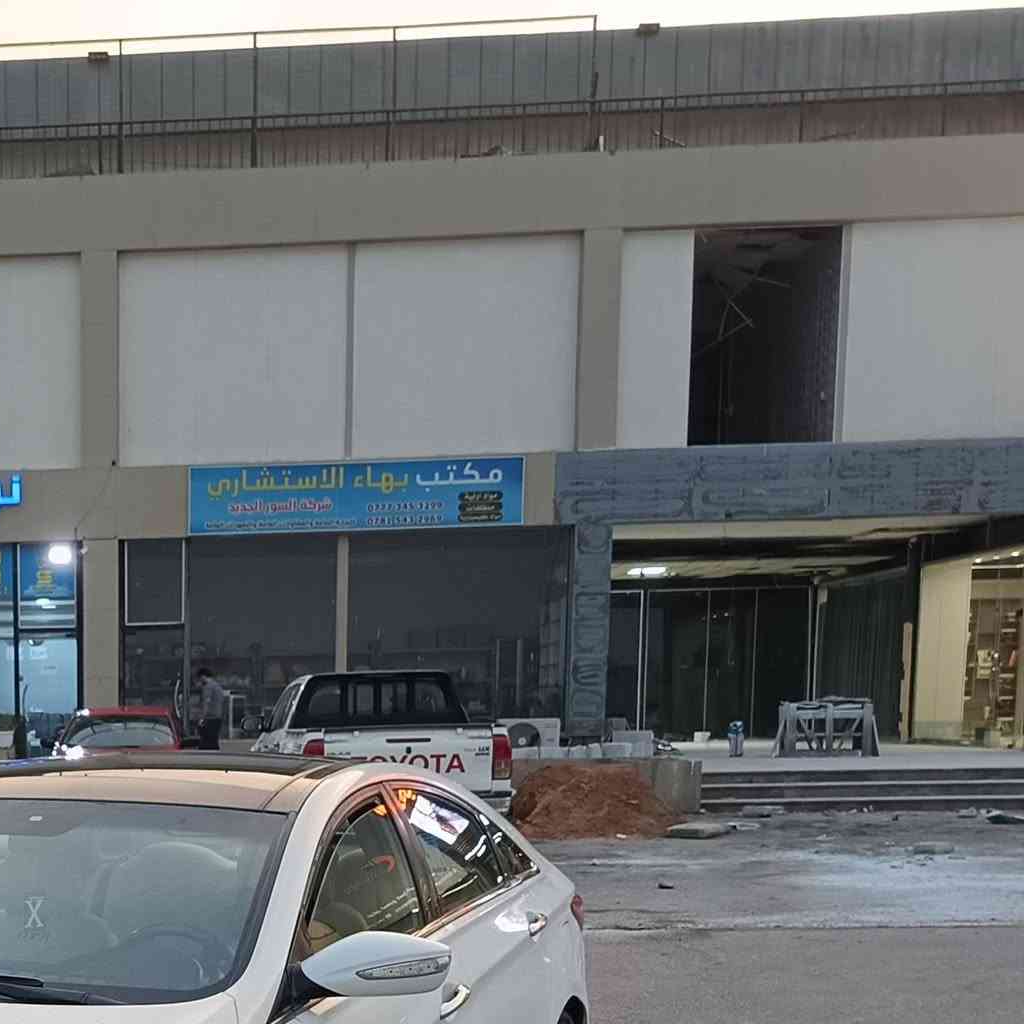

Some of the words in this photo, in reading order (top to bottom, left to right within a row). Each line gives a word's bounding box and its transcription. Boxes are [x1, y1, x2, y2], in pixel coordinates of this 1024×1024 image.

[208, 466, 344, 500] الاستشاري
[353, 465, 408, 494] بهاء
[416, 462, 503, 492] مكتب
